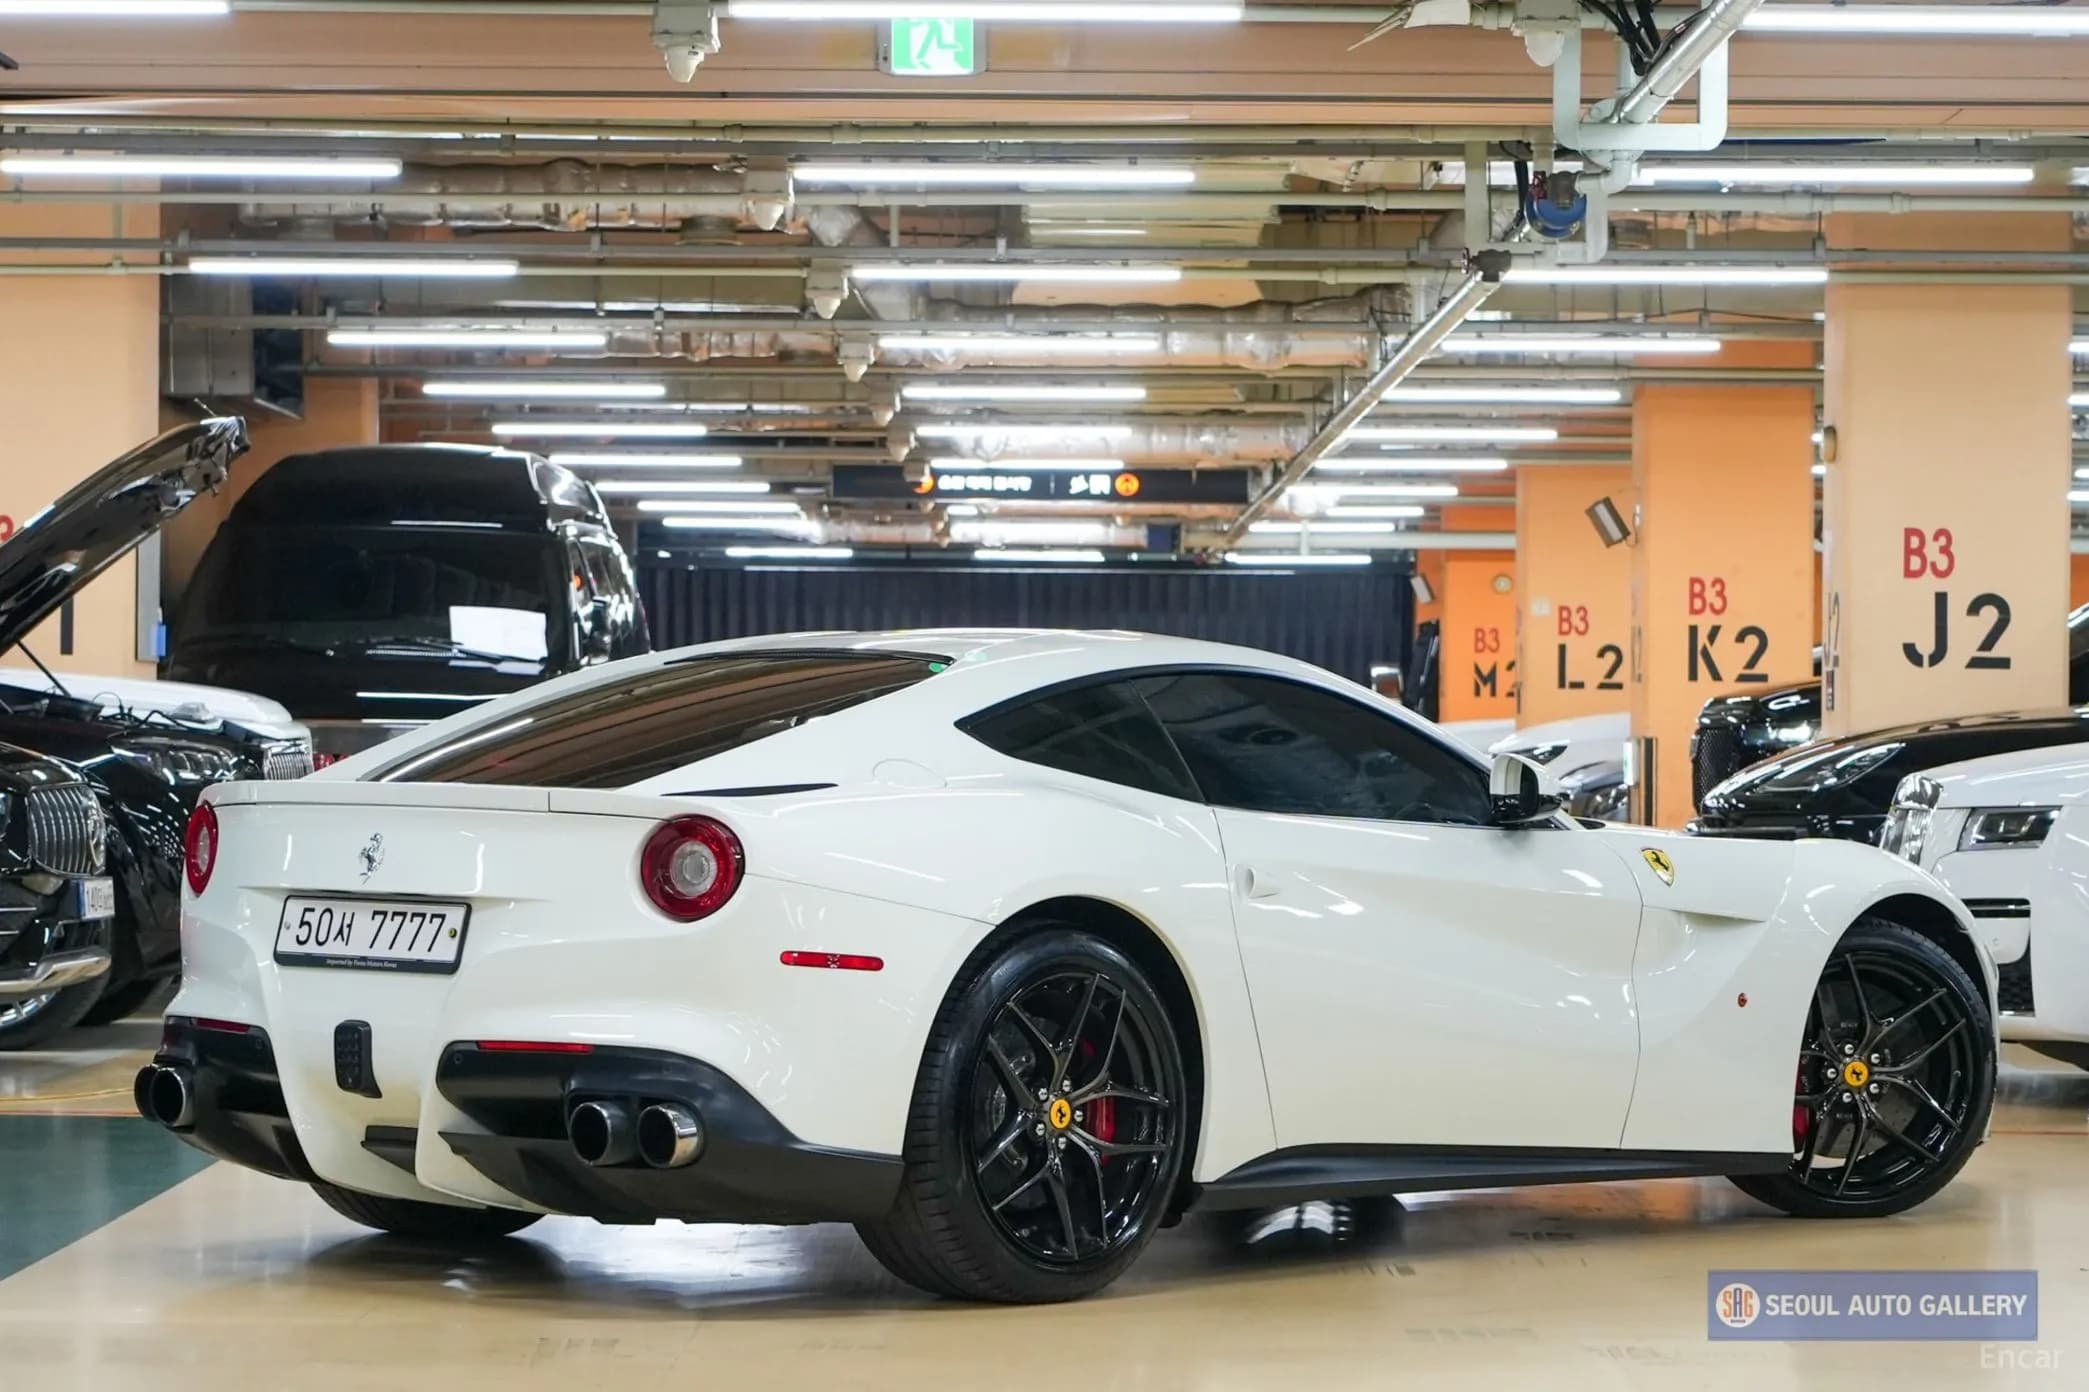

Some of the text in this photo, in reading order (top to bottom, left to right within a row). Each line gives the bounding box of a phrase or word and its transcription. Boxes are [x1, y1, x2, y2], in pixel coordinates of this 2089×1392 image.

[1903, 527, 1955, 579] B3
[1688, 577, 1728, 616] B3
[1474, 628, 1500, 653] B3
[1557, 605, 1589, 636] B3
[1902, 591, 2012, 669] J2
[1557, 643, 1624, 690] L2
[1687, 625, 1769, 683] K2
[296, 907, 447, 953] 50서 7777
